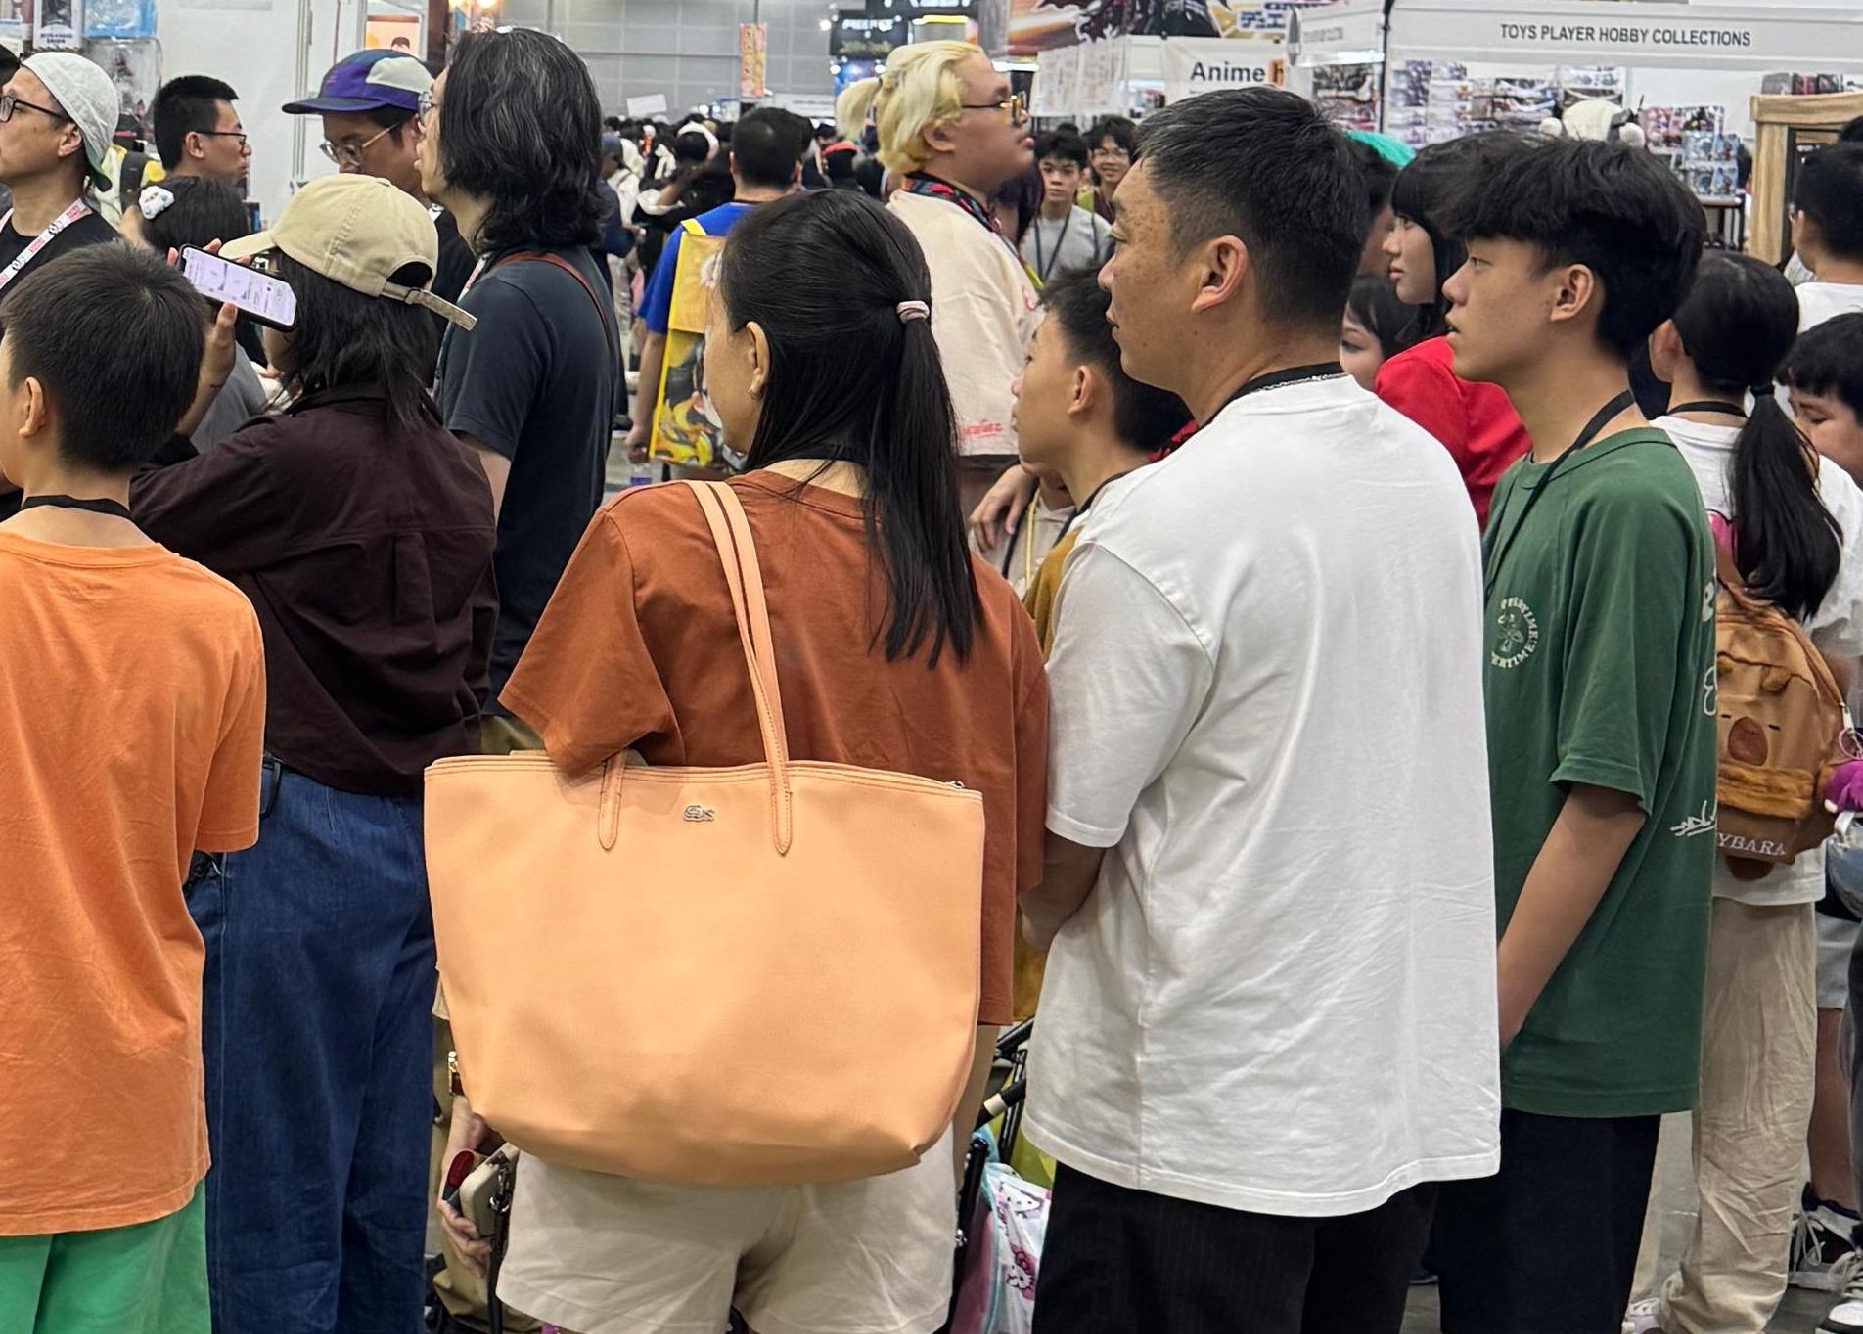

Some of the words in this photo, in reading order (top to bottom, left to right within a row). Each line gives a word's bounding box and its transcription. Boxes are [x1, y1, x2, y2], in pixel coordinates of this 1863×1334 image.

[1501, 24, 1537, 40] TOYS
[1541, 25, 1595, 42] PLAYER
[1599, 27, 1649, 44] HOBBY
[1652, 29, 1751, 47] COLLECTIONS
[1191, 61, 1266, 84] Anime
